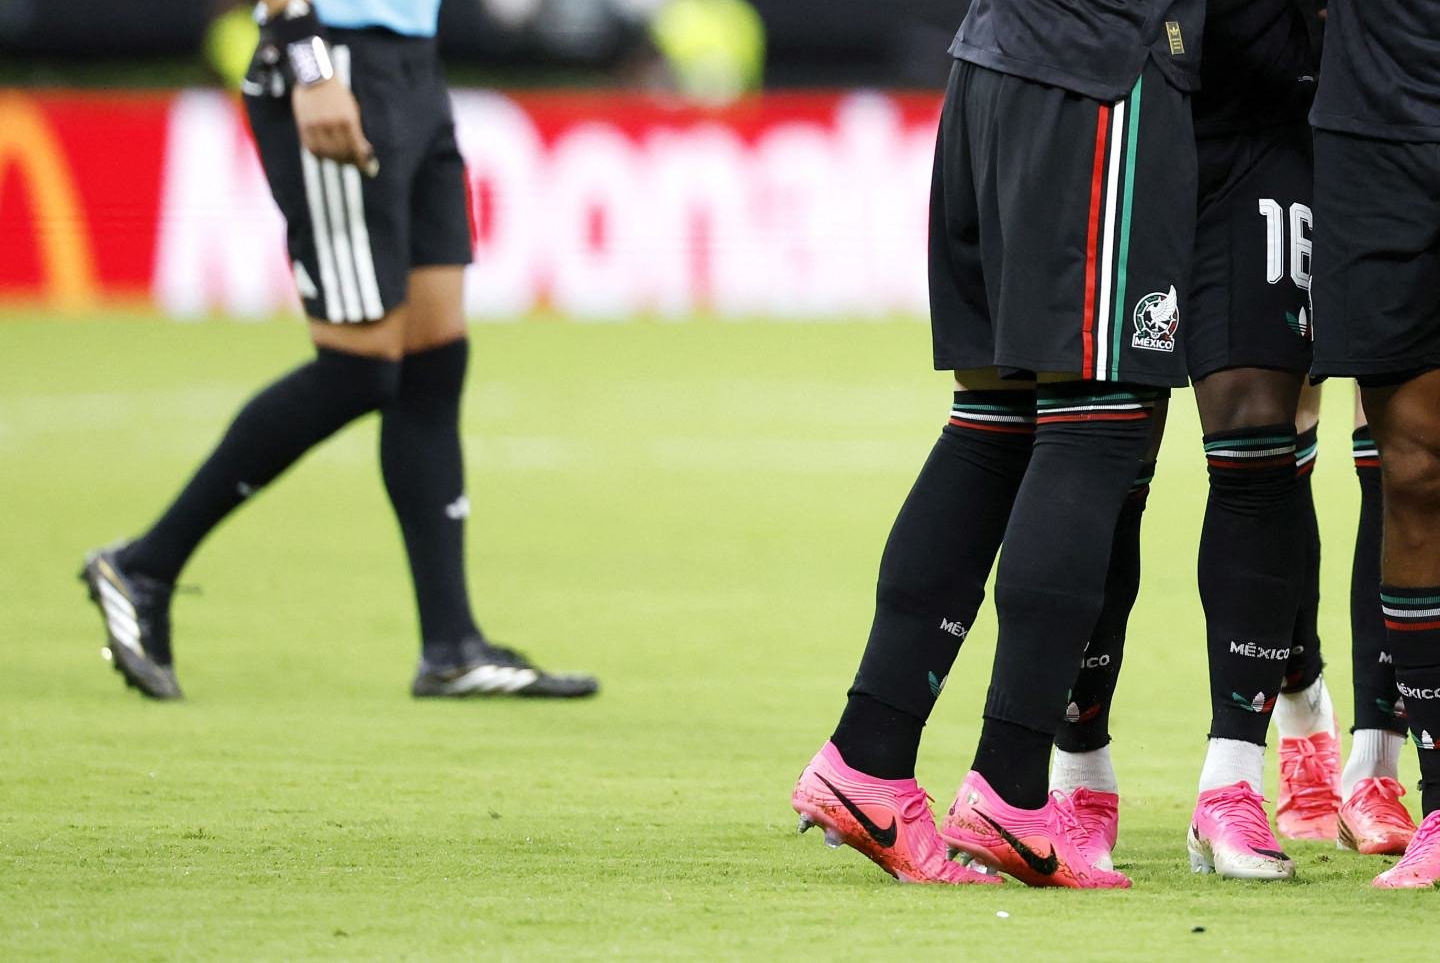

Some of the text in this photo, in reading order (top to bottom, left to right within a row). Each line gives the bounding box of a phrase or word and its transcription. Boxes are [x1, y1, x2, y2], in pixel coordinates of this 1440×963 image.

[1259, 198, 1313, 290] 16
[1134, 336, 1173, 350] MÉXICO
[939, 617, 968, 638] MÉX
[1229, 640, 1291, 660] MÉXICO
[1080, 653, 1110, 669] ICO
